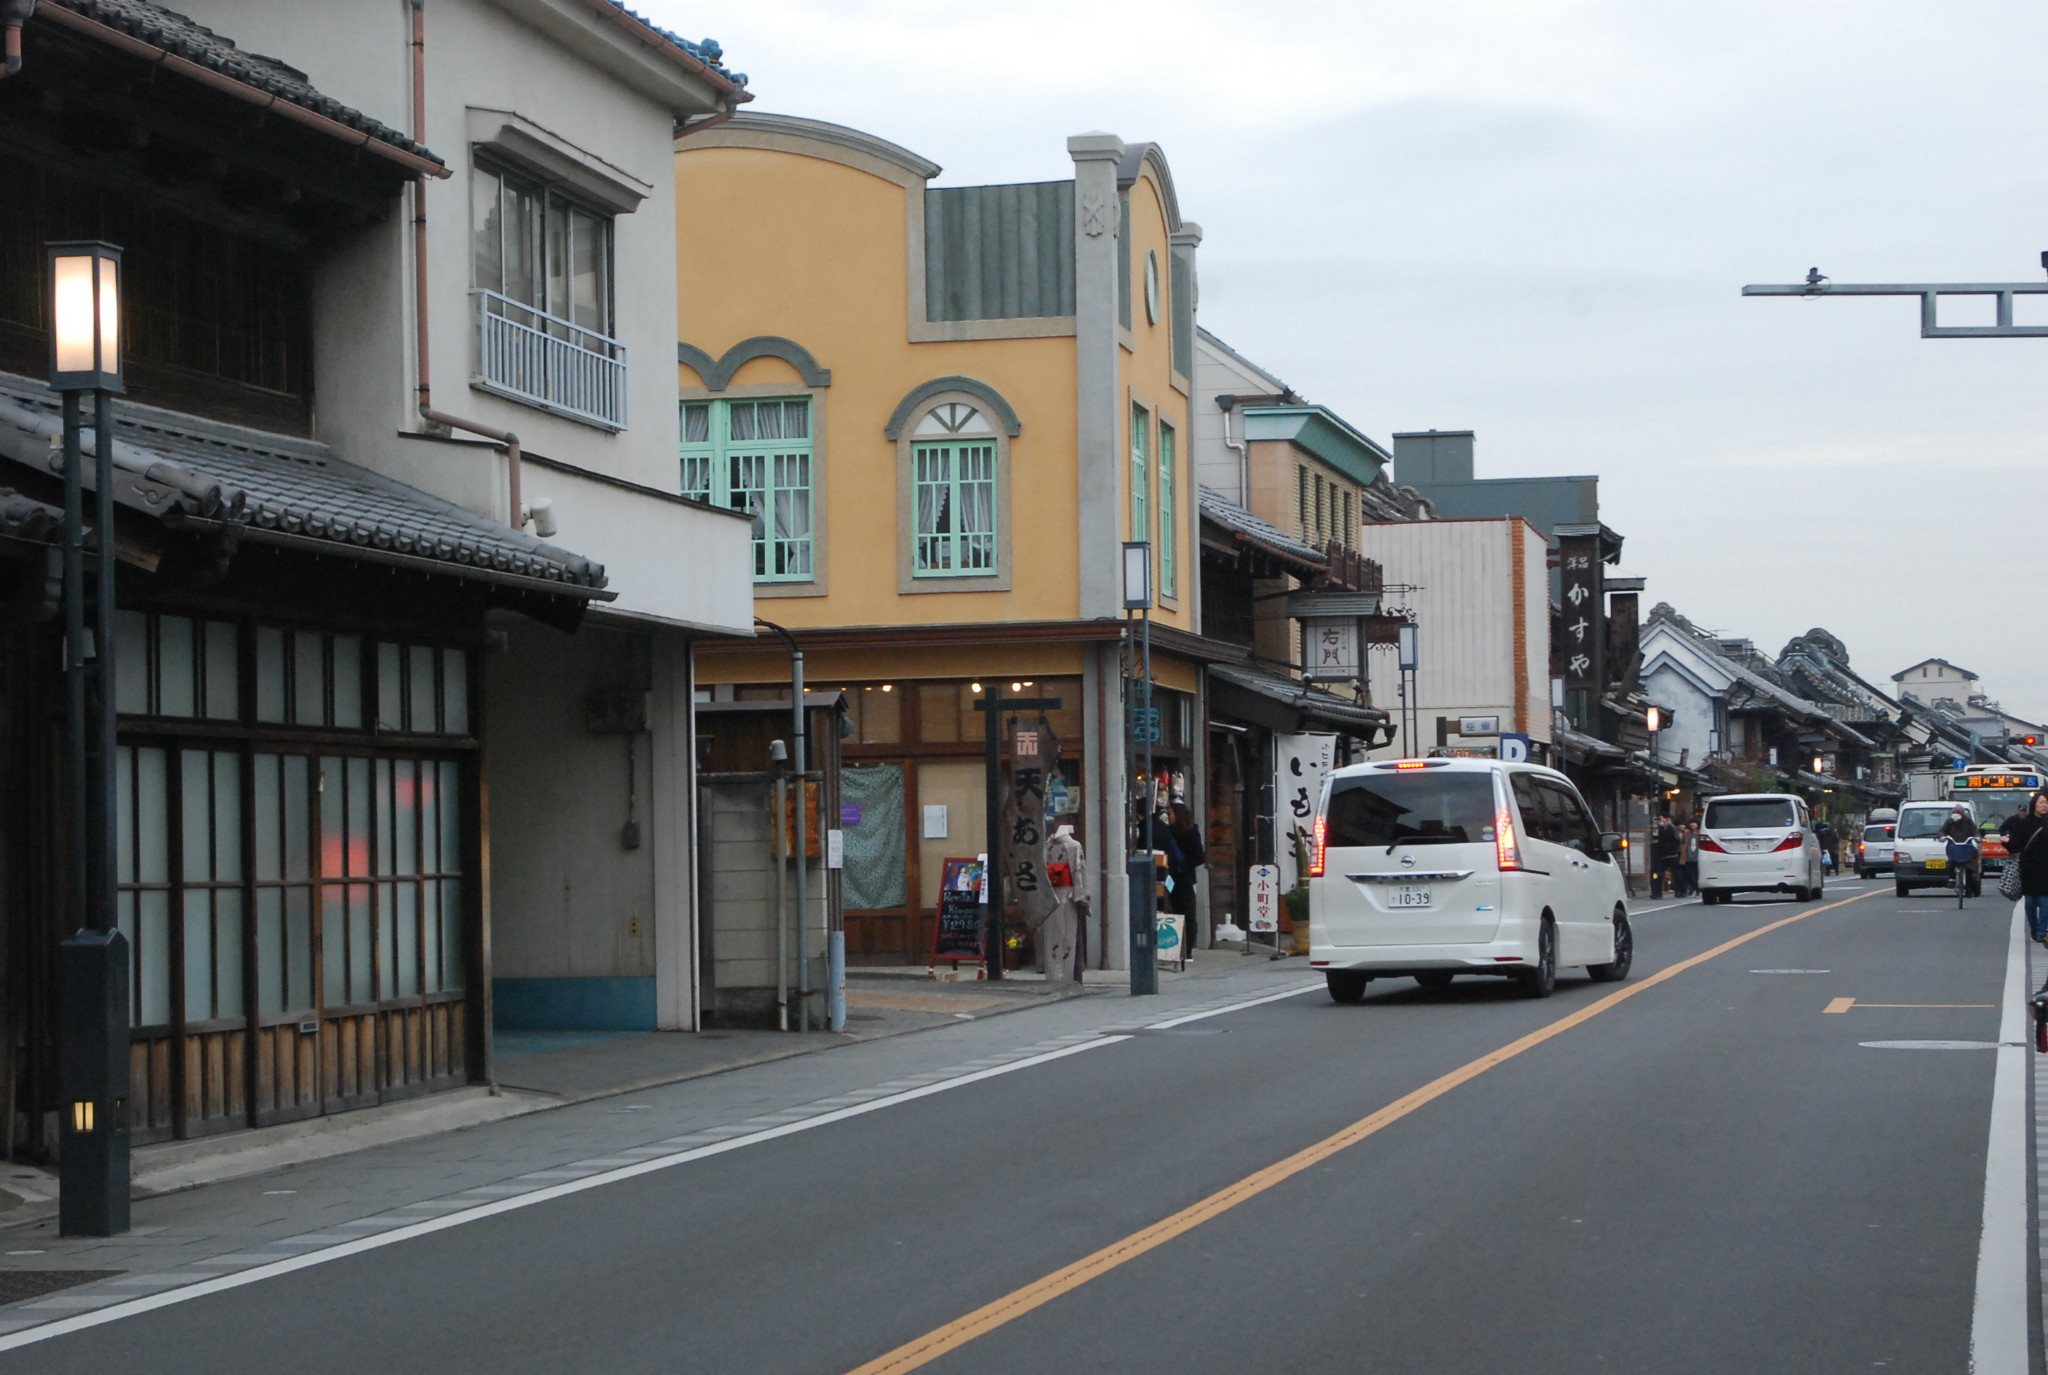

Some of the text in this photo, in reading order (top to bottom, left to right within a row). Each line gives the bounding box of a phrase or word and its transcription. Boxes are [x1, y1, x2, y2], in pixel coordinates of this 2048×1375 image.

[1322, 627, 1340, 665] 右門
[1568, 583, 1590, 678] かすや
[1257, 880, 1269, 918] 小町堂
[1399, 893, 1429, 904] 10-39
